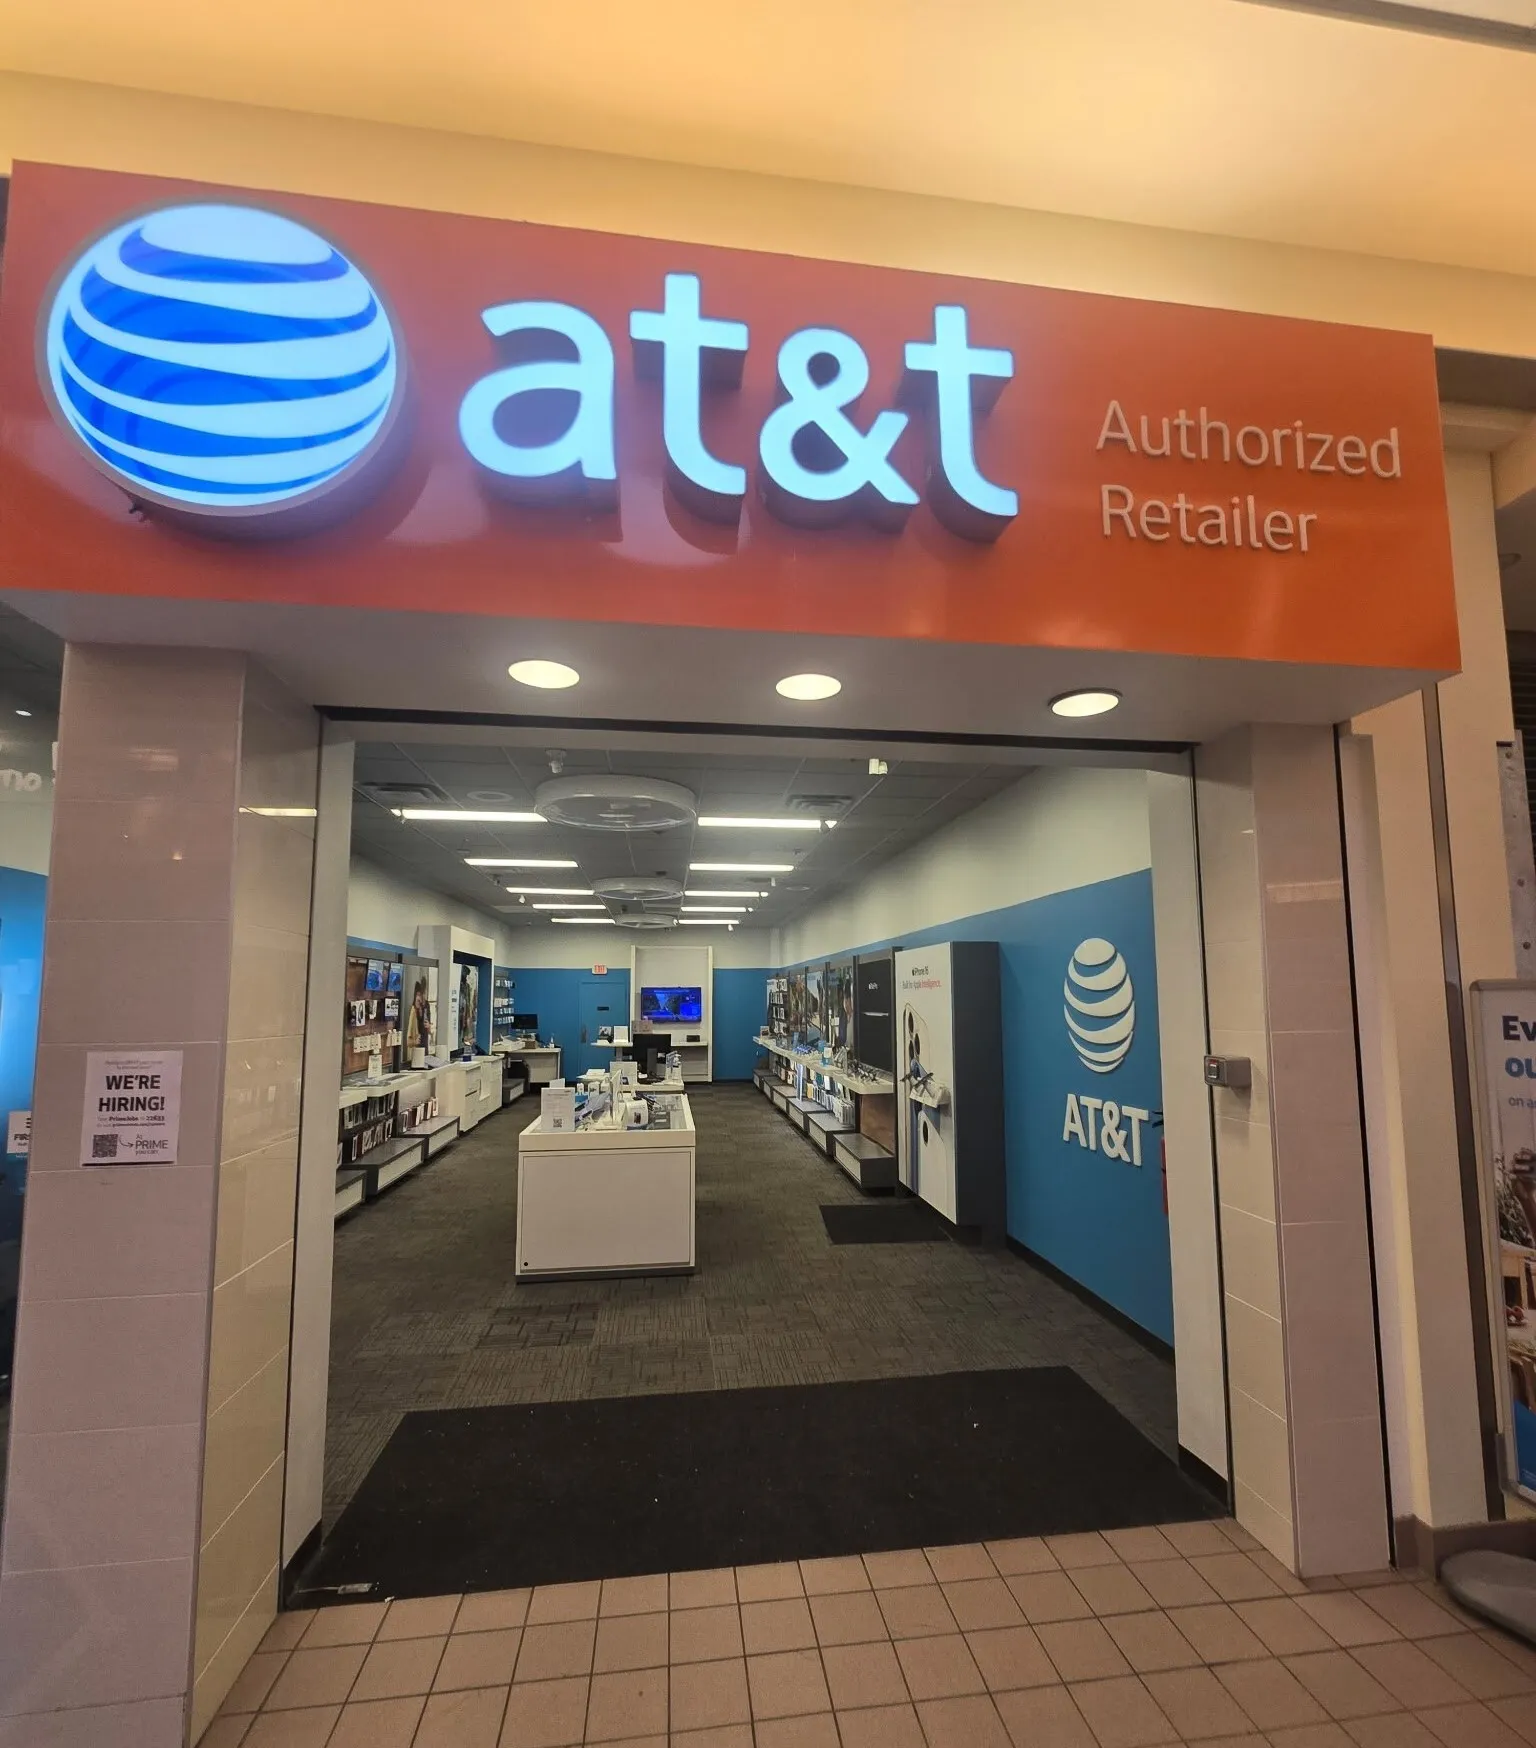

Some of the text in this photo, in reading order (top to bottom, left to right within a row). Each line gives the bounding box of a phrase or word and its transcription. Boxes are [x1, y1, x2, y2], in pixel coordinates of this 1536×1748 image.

[459, 272, 1018, 516] at&t
[1096, 400, 1402, 478] Authorized
[1101, 484, 1317, 553] Retailer
[98, 1096, 165, 1112] HIRING!
[105, 1074, 161, 1091] WE'RE
[1526, 1098, 1536, 1108] a
[135, 1140, 169, 1150] PRIME
[1062, 1093, 1149, 1167] AT&T
